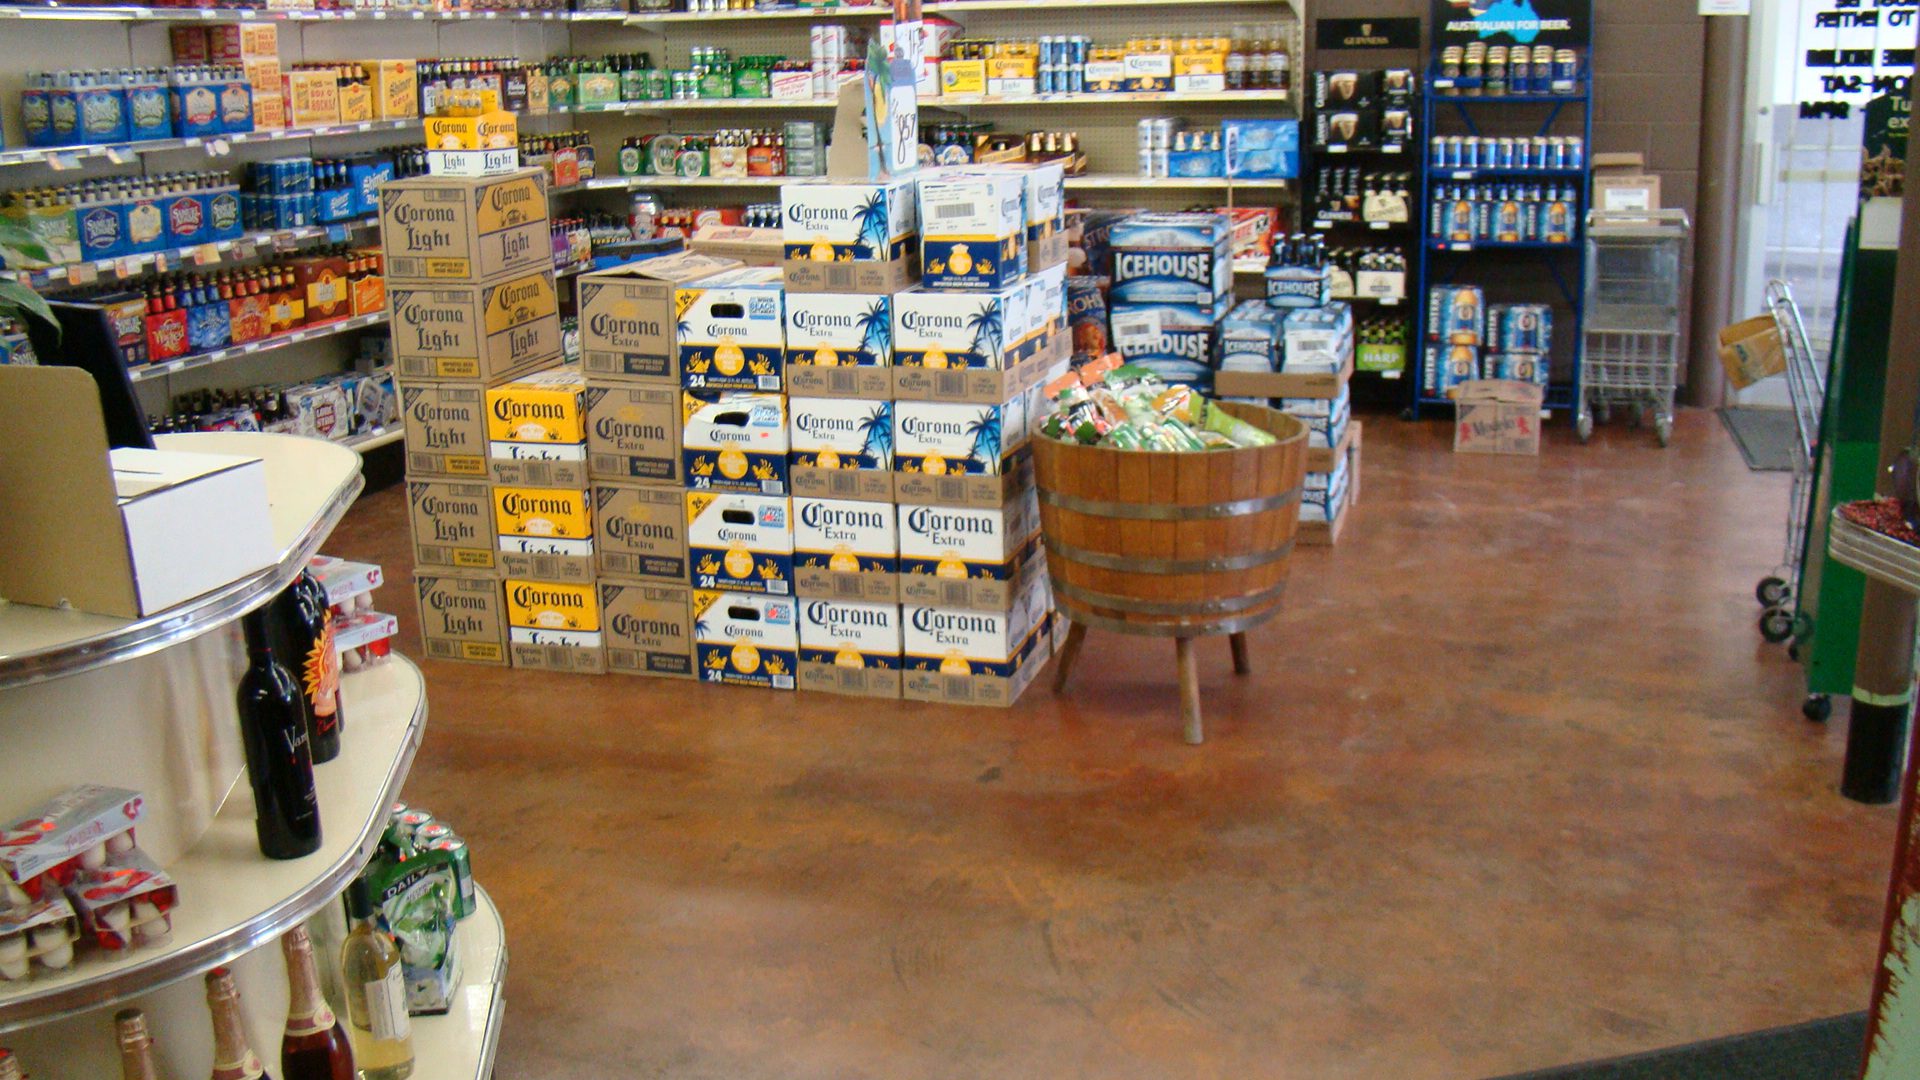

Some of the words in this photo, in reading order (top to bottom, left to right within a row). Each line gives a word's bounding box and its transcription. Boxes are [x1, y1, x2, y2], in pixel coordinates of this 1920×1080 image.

[1446, 20, 1515, 31] AUSTRALIAN
[1517, 20, 1538, 30] FOR
[1344, 36, 1389, 45] GUINNESS
[433, 120, 467, 136] Corona
[478, 121, 515, 136] Corona
[443, 152, 465, 170] Light
[484, 152, 512, 170] Light
[492, 184, 531, 212] Corona
[394, 203, 456, 225] Corona
[788, 203, 849, 225] Corona
[805, 221, 830, 231] Extra
[406, 225, 450, 251] Light
[500, 232, 530, 261] Light
[1115, 252, 1210, 283] ICEHOUSE
[500, 282, 540, 312] Corona
[1268, 280, 1319, 297] ICEHOUSE
[404, 304, 463, 327] Corona
[590, 313, 660, 338] Corona
[793, 310, 852, 331] Corona
[901, 310, 962, 332] Corona
[417, 327, 460, 351] Light
[707, 323, 748, 337] Corona
[808, 327, 833, 338] Extra
[918, 328, 943, 338] Extra
[509, 328, 539, 359] Light
[611, 336, 640, 348] Extra
[1225, 339, 1269, 353] ICEHOUSE
[1363, 353, 1400, 364] HARP
[689, 374, 706, 388] 24
[414, 402, 470, 424] Corona
[494, 397, 565, 424] Corona
[596, 416, 665, 442] Corona
[796, 413, 854, 434] Corona
[901, 416, 961, 437] Corona
[424, 425, 466, 448] Light
[616, 439, 645, 450] Extra
[710, 429, 750, 443] Corona
[812, 429, 835, 440] Extra
[918, 433, 942, 444] Extra
[694, 476, 710, 488] 24
[422, 496, 478, 517] Corona
[502, 493, 572, 519] Corona
[801, 502, 883, 532] Corona
[908, 506, 993, 538] Corona
[433, 517, 475, 541] Light
[606, 515, 674, 542] Corona
[718, 528, 757, 542] Corona
[824, 527, 857, 541] Extra
[932, 532, 965, 546] Extra
[627, 538, 654, 550] Extra
[700, 576, 716, 588] 24
[430, 590, 487, 611] Corona
[513, 585, 584, 612] Corona
[442, 612, 483, 635] Light
[807, 601, 888, 629] Corona
[912, 607, 997, 637] Corona
[612, 613, 681, 639] Corona
[724, 624, 764, 639] Corona
[830, 624, 861, 638] Extra
[634, 636, 662, 648] Extra
[936, 631, 969, 645] Extra
[707, 670, 722, 682] 24
